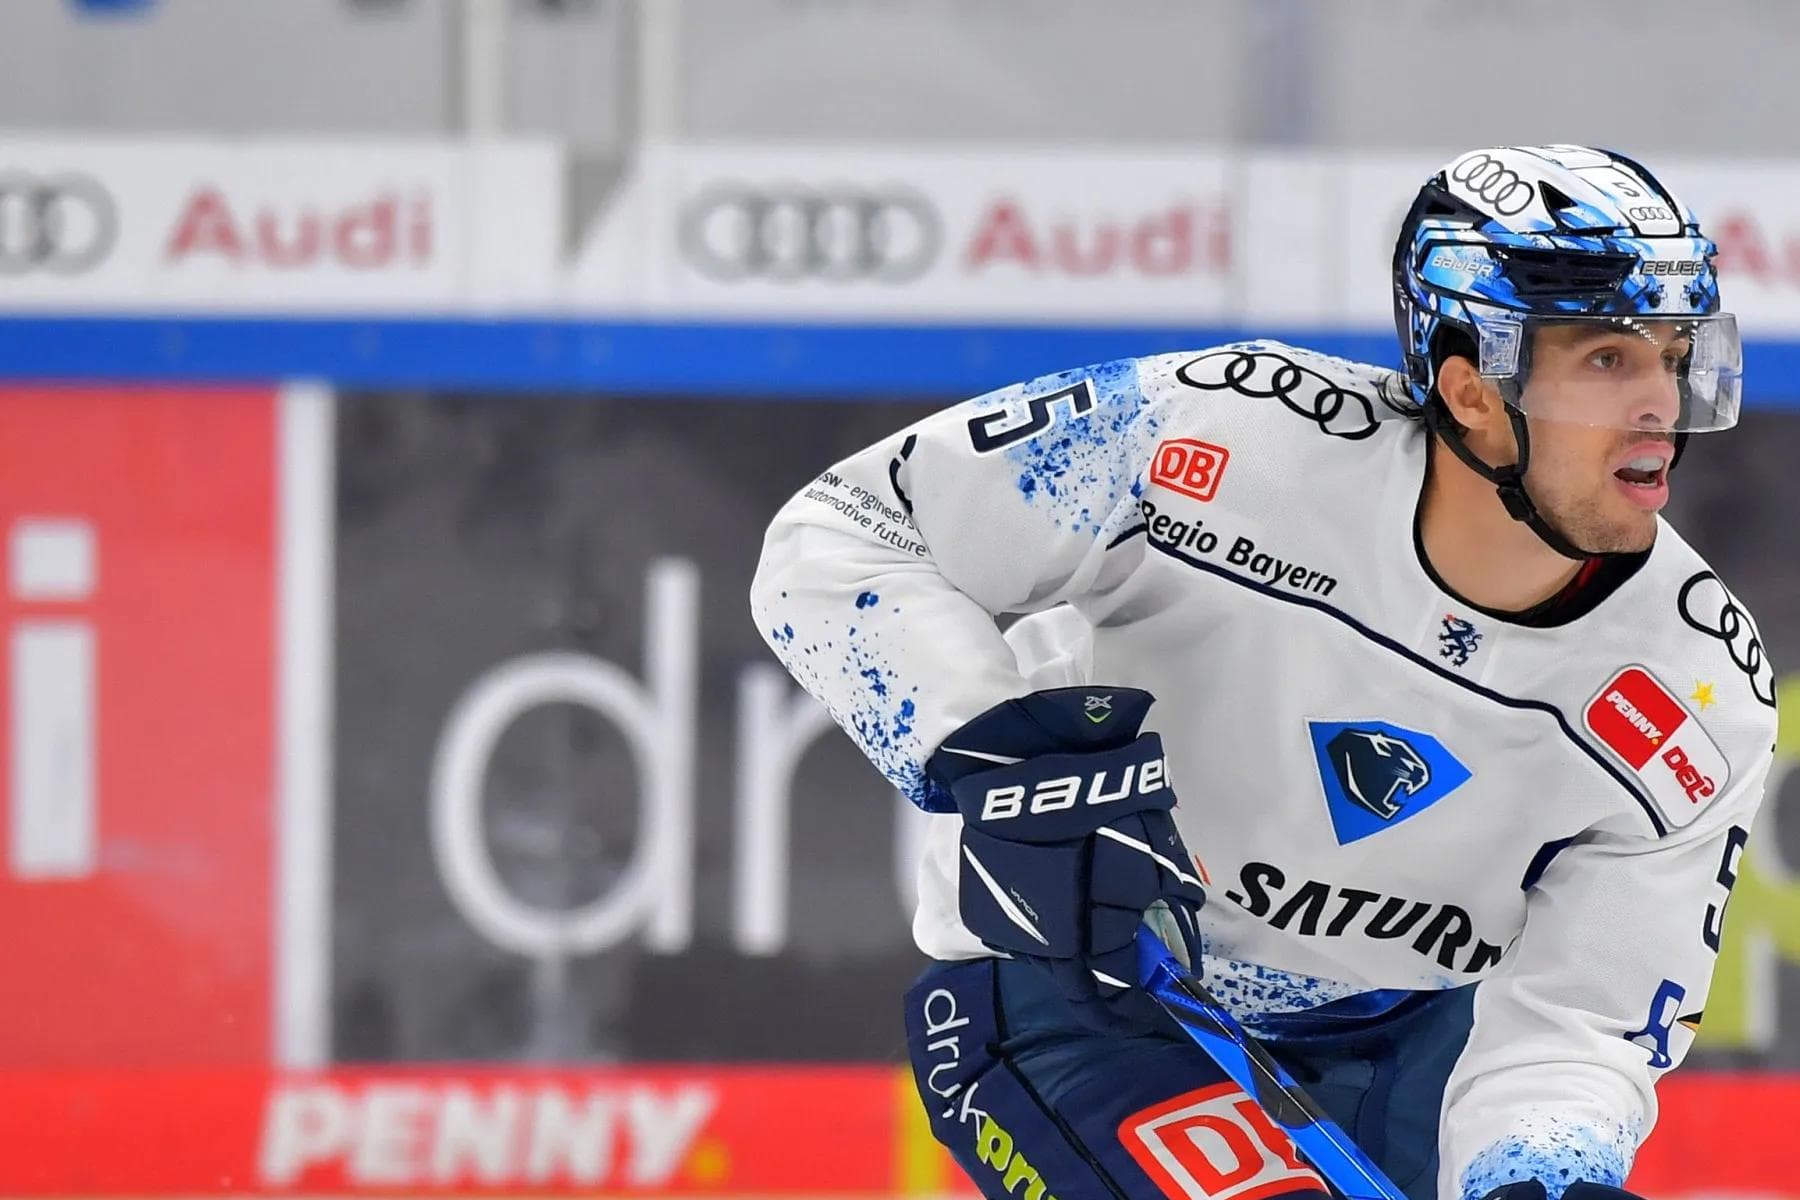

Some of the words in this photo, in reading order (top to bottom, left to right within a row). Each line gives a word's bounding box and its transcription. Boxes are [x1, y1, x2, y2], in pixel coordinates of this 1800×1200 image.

[165, 184, 437, 270] Audi
[965, 196, 1231, 277] Audi
[967, 379, 1096, 454] 5
[816, 471, 843, 488] sw
[1158, 446, 1216, 490] DB
[872, 522, 928, 558] future
[1141, 500, 1219, 554] Regio
[1225, 535, 1338, 597] Bayern
[1605, 689, 1664, 746] PENNY.
[254, 1084, 728, 1188] PENNY.
